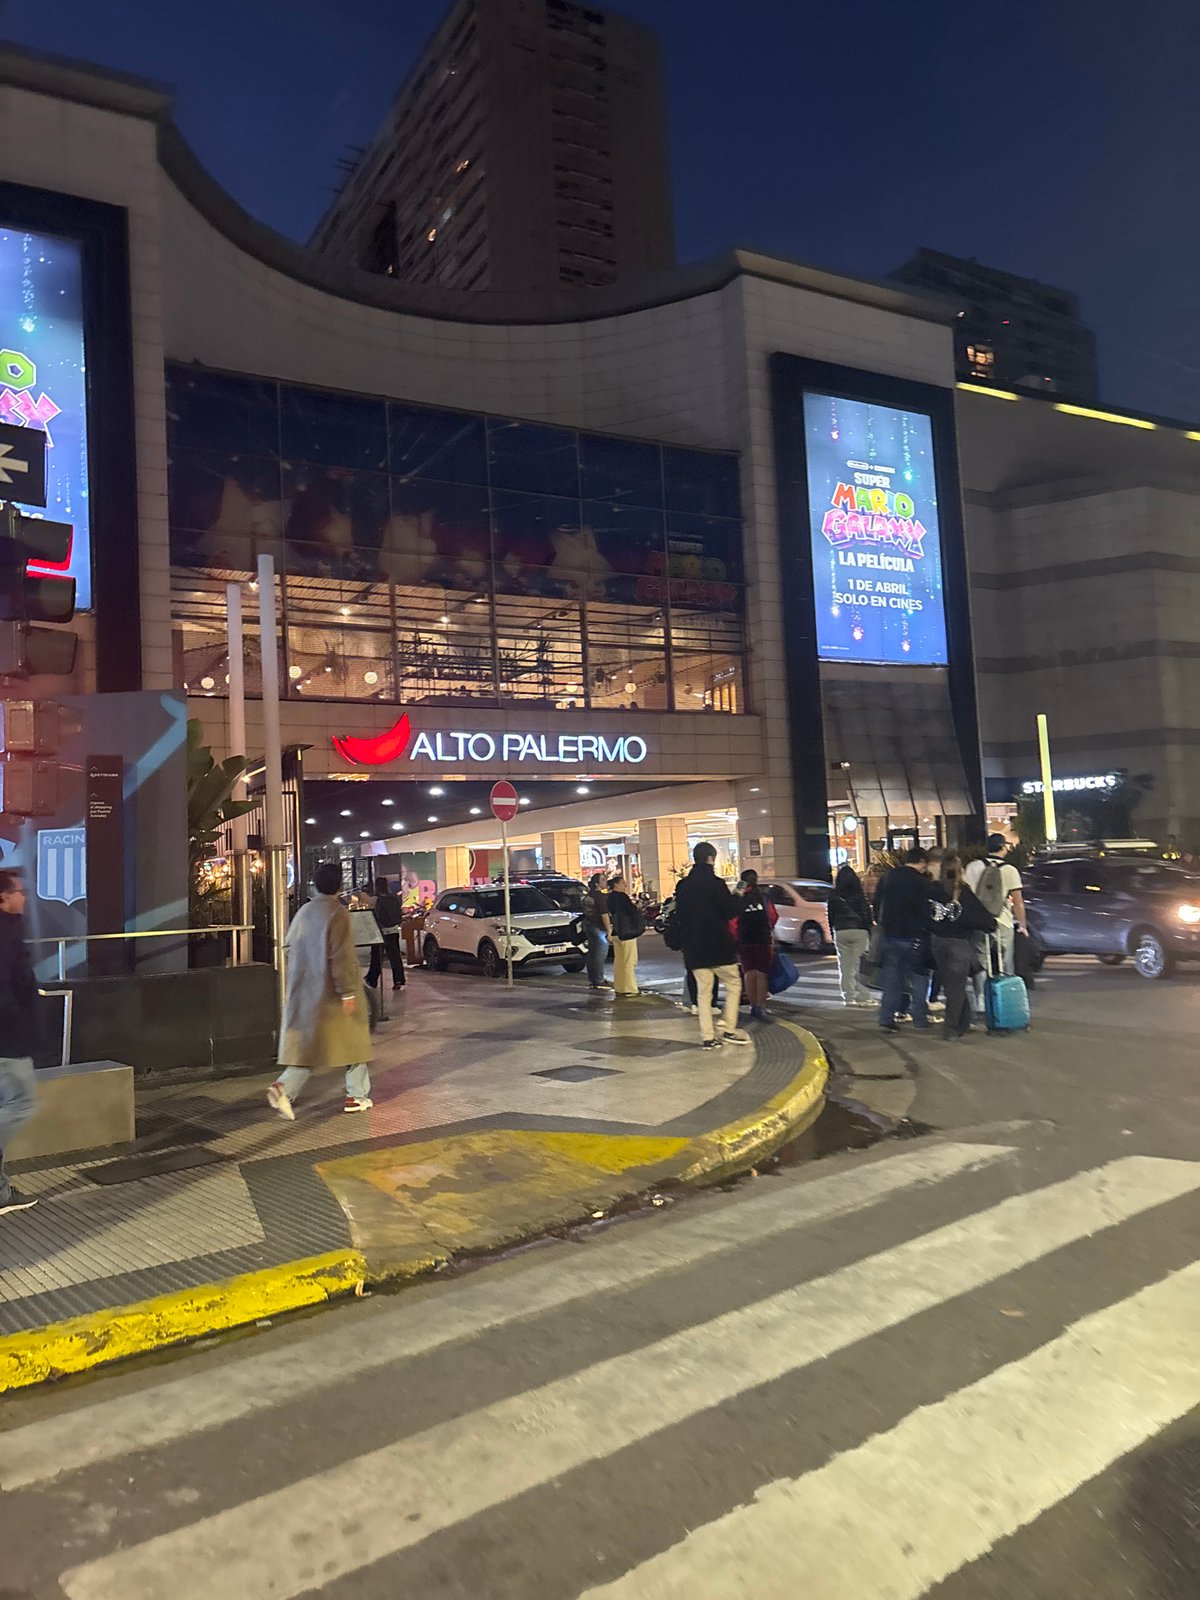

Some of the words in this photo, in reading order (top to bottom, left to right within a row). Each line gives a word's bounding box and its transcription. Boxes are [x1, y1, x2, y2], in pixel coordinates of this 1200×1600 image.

[853, 472, 891, 488] SUPER
[831, 481, 915, 520] MARIO
[821, 508, 927, 558] GALAXY
[839, 552, 856, 567] LA
[856, 552, 914, 573] PELÍCULA
[848, 579, 854, 590] 1
[856, 580, 874, 592] DE
[875, 581, 909, 595] ABRIL
[836, 592, 867, 606] SOLO
[870, 595, 887, 607] EN
[889, 597, 923, 611] CINES
[410, 731, 495, 762] ALTO
[502, 733, 647, 763] PALERMO
[43, 834, 86, 845] RACIN
